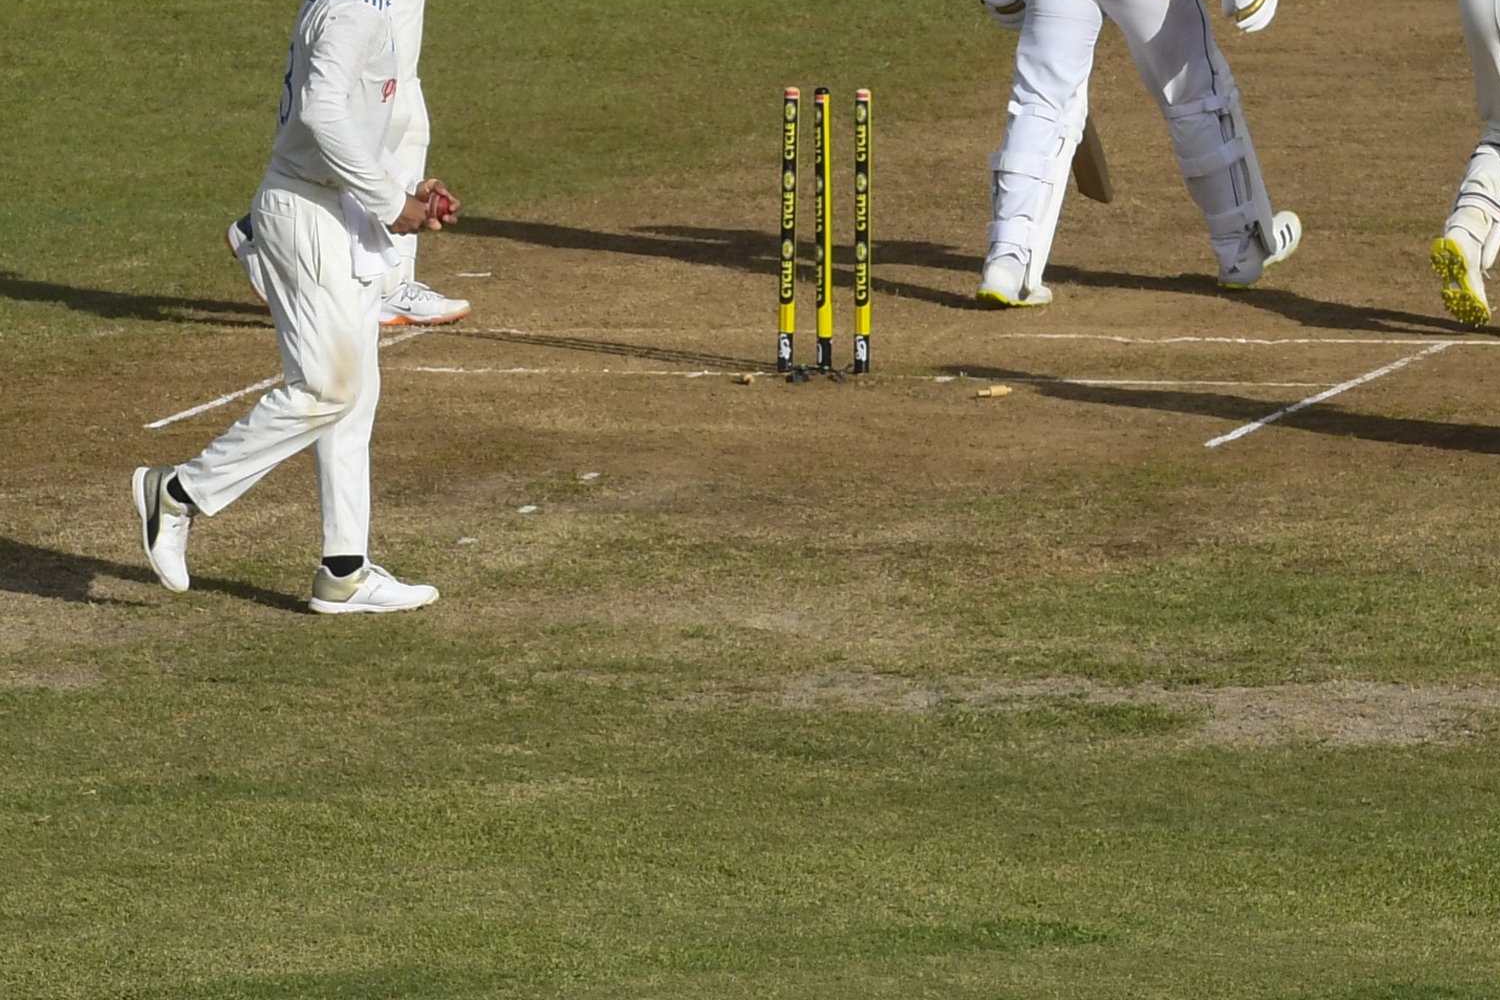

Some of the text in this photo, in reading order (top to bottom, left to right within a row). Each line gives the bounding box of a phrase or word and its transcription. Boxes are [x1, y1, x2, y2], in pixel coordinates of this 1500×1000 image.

[784, 122, 795, 160] CYCLE
[856, 124, 866, 162] CYCLE
[783, 191, 794, 229] CYCLE
[856, 194, 866, 231] CYCLE
[781, 260, 792, 298] CYCLE
[856, 263, 866, 300] CYCLE
